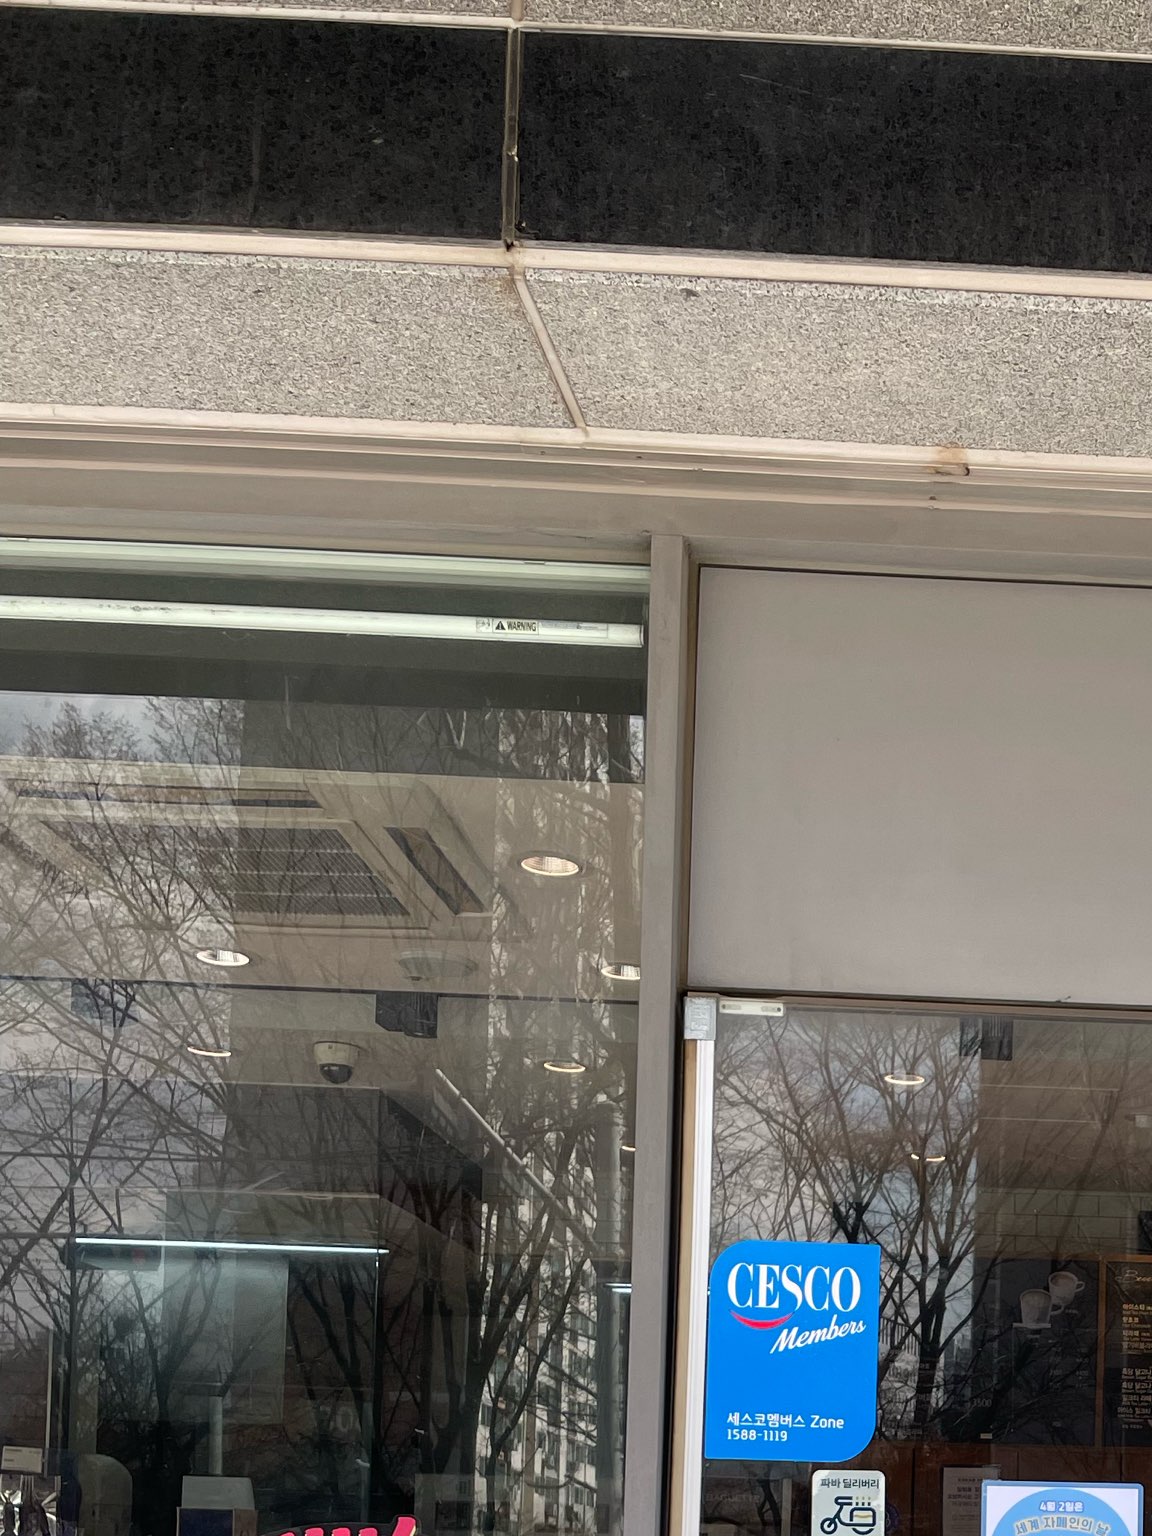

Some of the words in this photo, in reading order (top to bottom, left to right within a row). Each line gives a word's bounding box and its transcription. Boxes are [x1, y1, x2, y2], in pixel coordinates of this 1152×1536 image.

[507, 621, 537, 632] WARNING
[727, 1262, 862, 1313] CESCO
[770, 1315, 867, 1354] Members
[726, 1412, 806, 1429] 세스코멤버스
[810, 1415, 845, 1429] Zone
[726, 1428, 788, 1442] 1588-1119
[842, 1478, 880, 1489] 딜리버리
